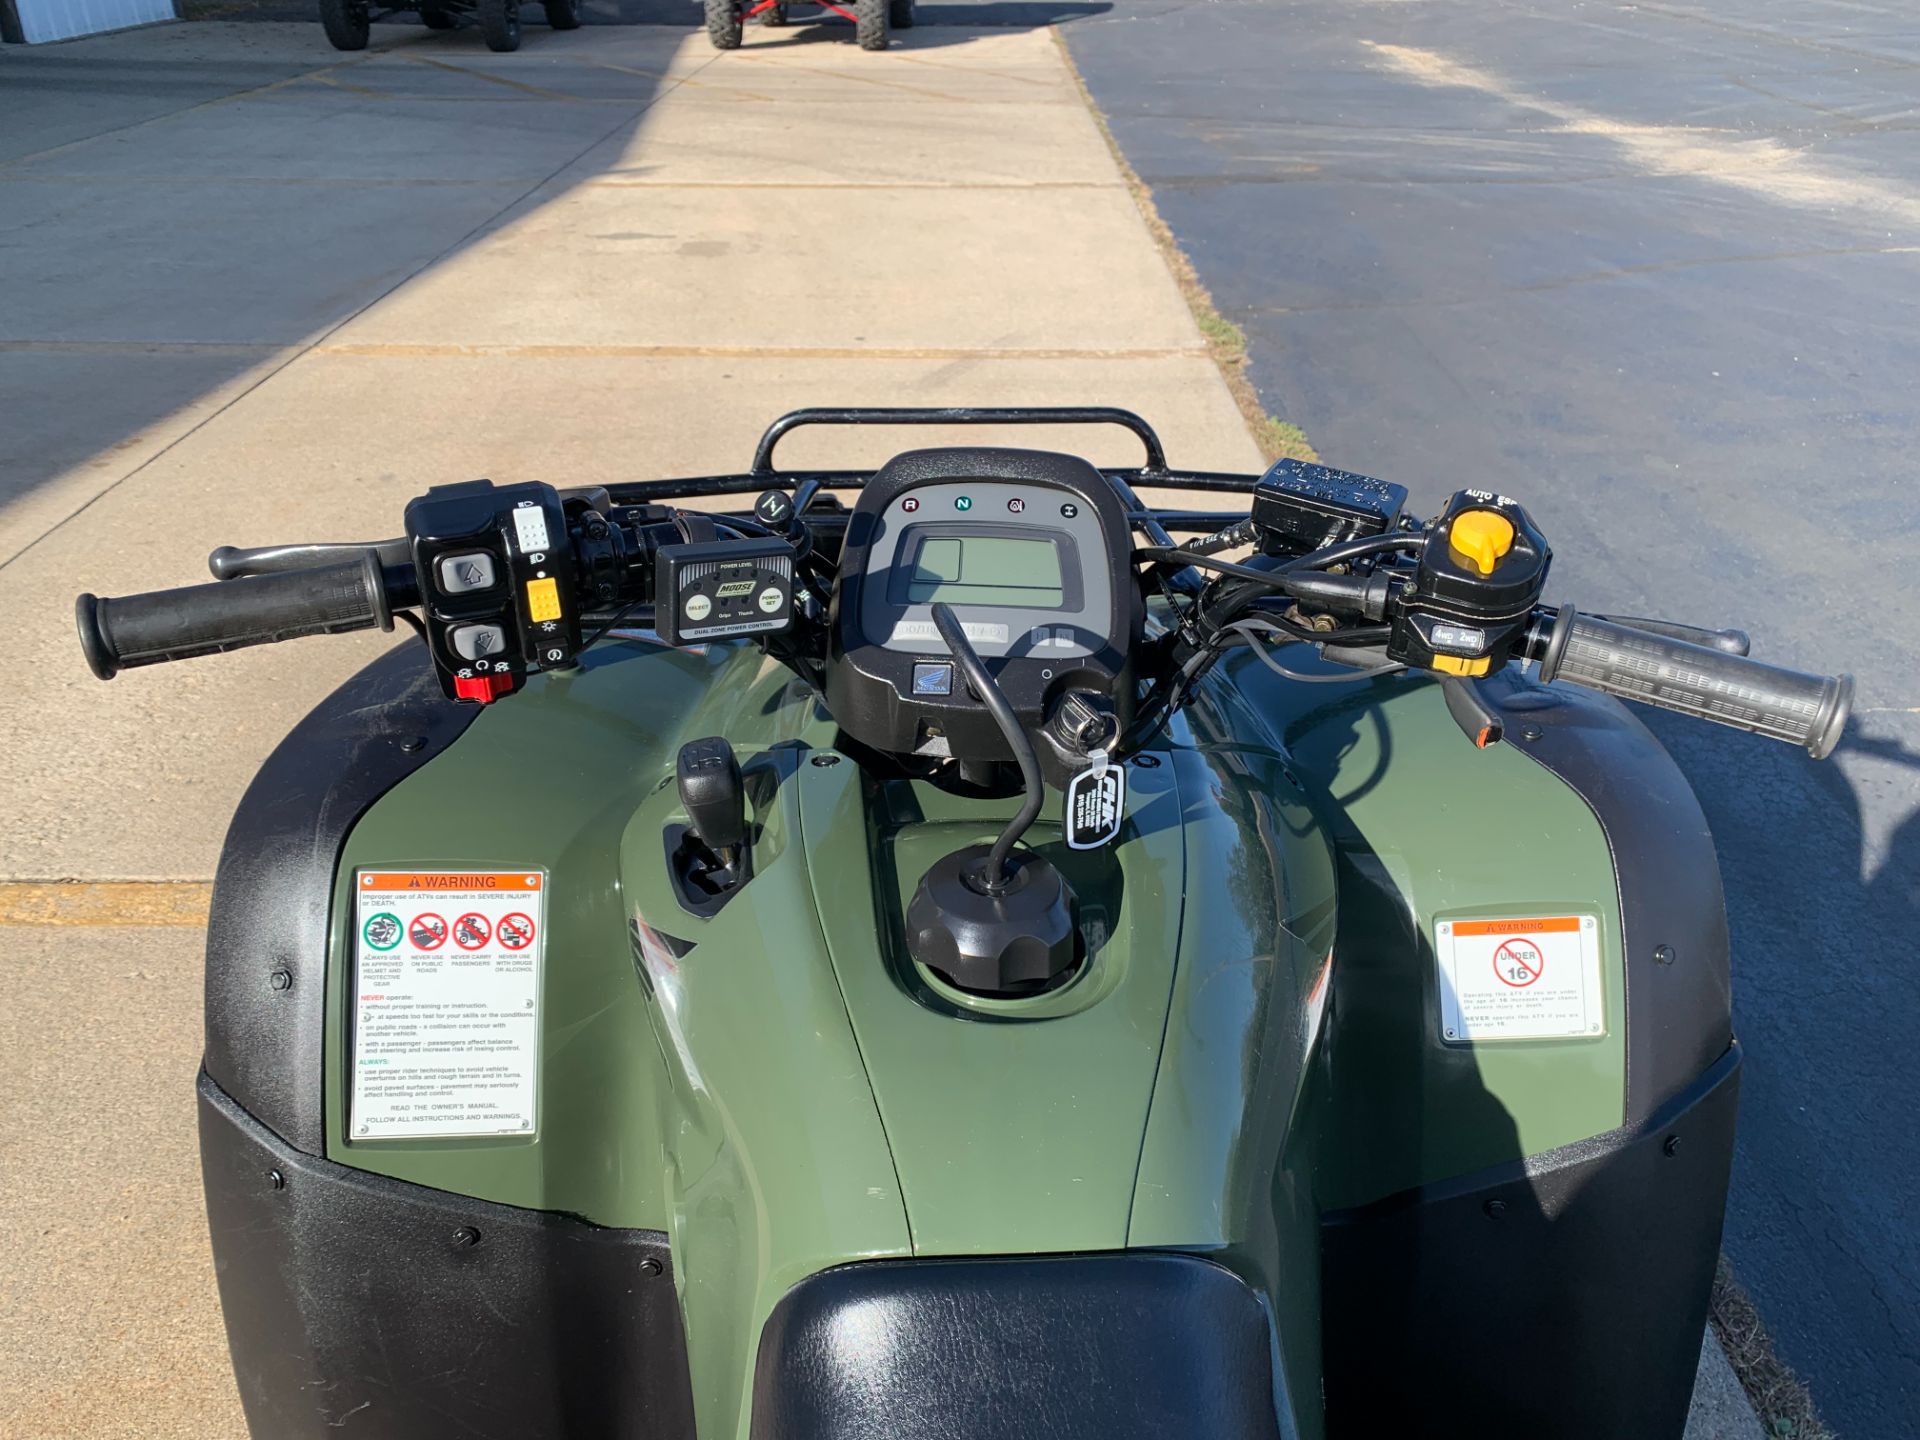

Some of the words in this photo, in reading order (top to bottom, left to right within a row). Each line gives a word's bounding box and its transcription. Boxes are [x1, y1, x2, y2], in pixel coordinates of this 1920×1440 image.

[1465, 489, 1493, 500] AUTO
[904, 500, 917, 510] R
[957, 499, 970, 508] N
[720, 582, 754, 592] MOOSE
[1436, 629, 1454, 640] 4WD
[1460, 632, 1478, 643] 2WD
[425, 876, 496, 888] WARNING
[1498, 922, 1544, 931] WARNING
[1500, 951, 1536, 961] UNDER
[1508, 966, 1528, 980] 16
